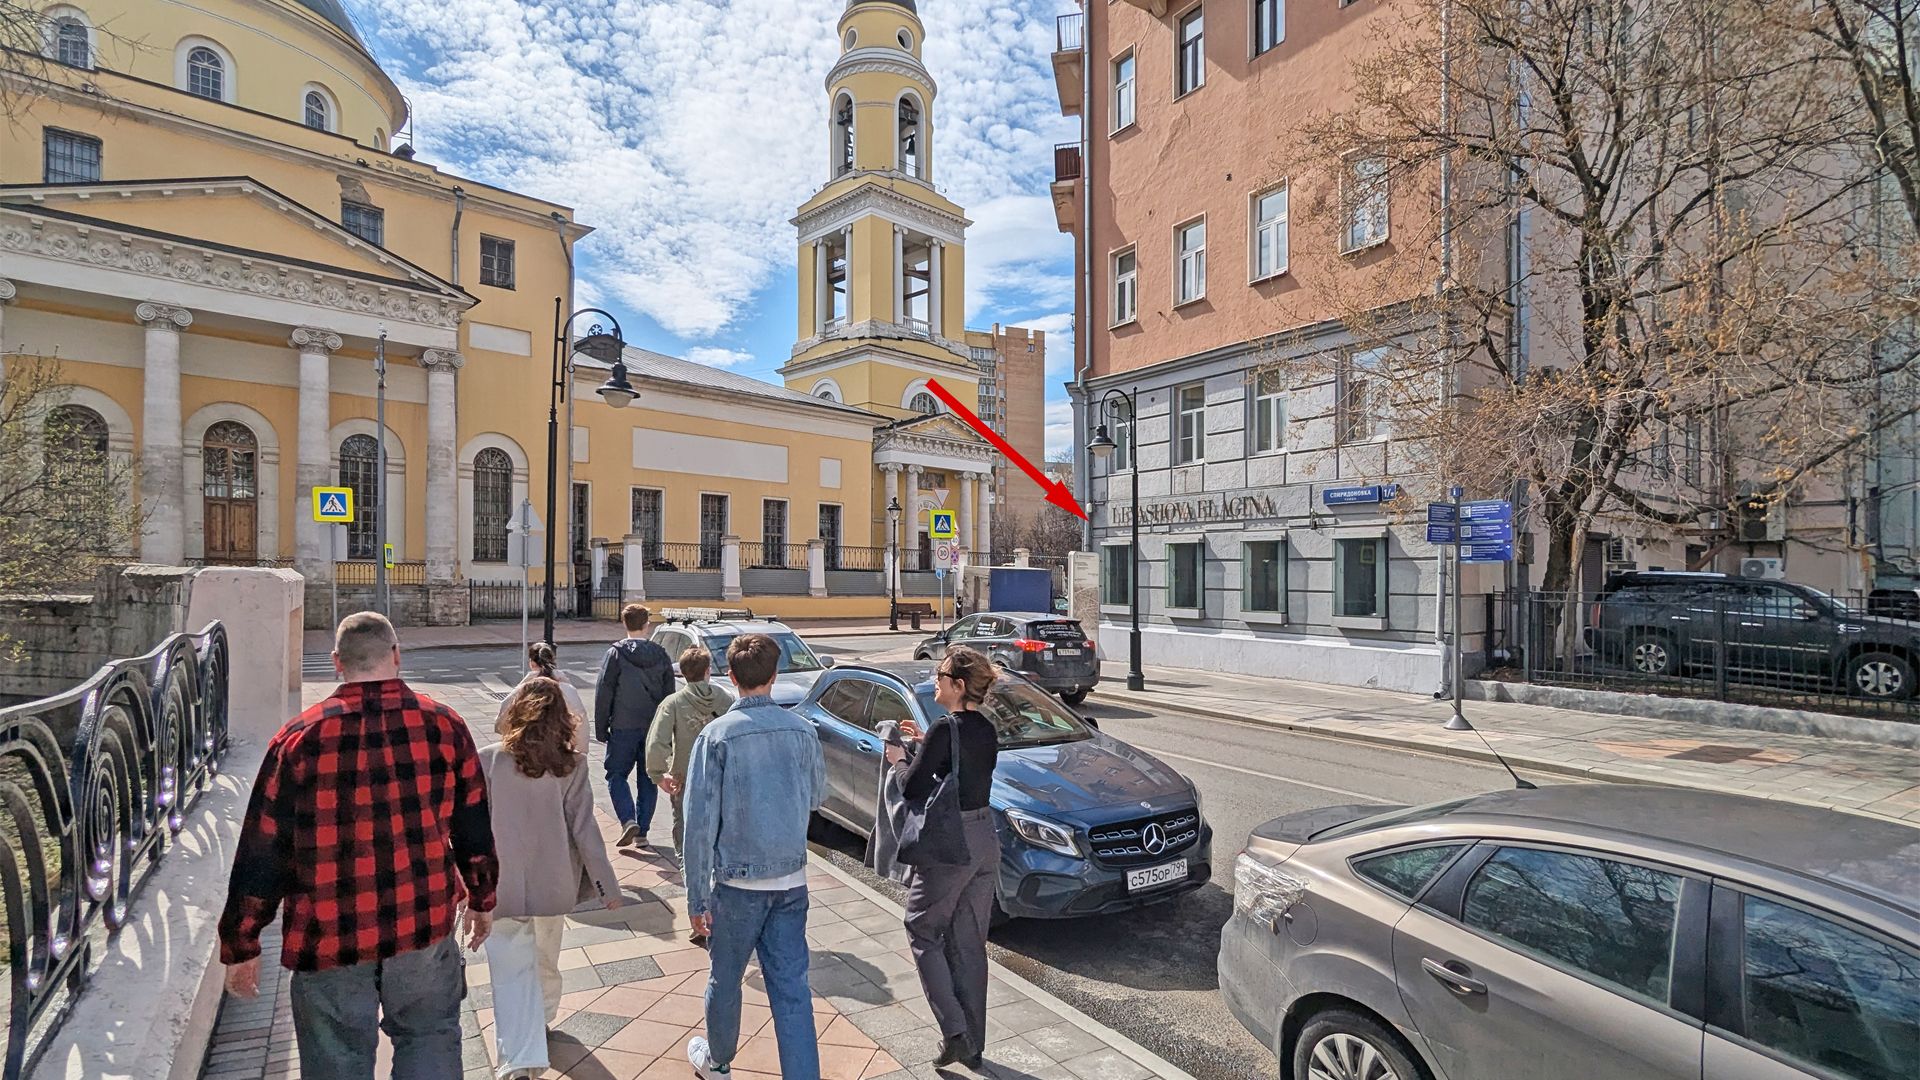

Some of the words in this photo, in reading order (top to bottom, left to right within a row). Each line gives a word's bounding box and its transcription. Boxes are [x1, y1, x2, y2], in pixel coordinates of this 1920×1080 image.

[1329, 489, 1372, 499] СПИРИДОНОВКА
[1112, 501, 1195, 523] LEASHOVA
[1197, 494, 1275, 518] ELAGINA
[1171, 861, 1185, 874] 799
